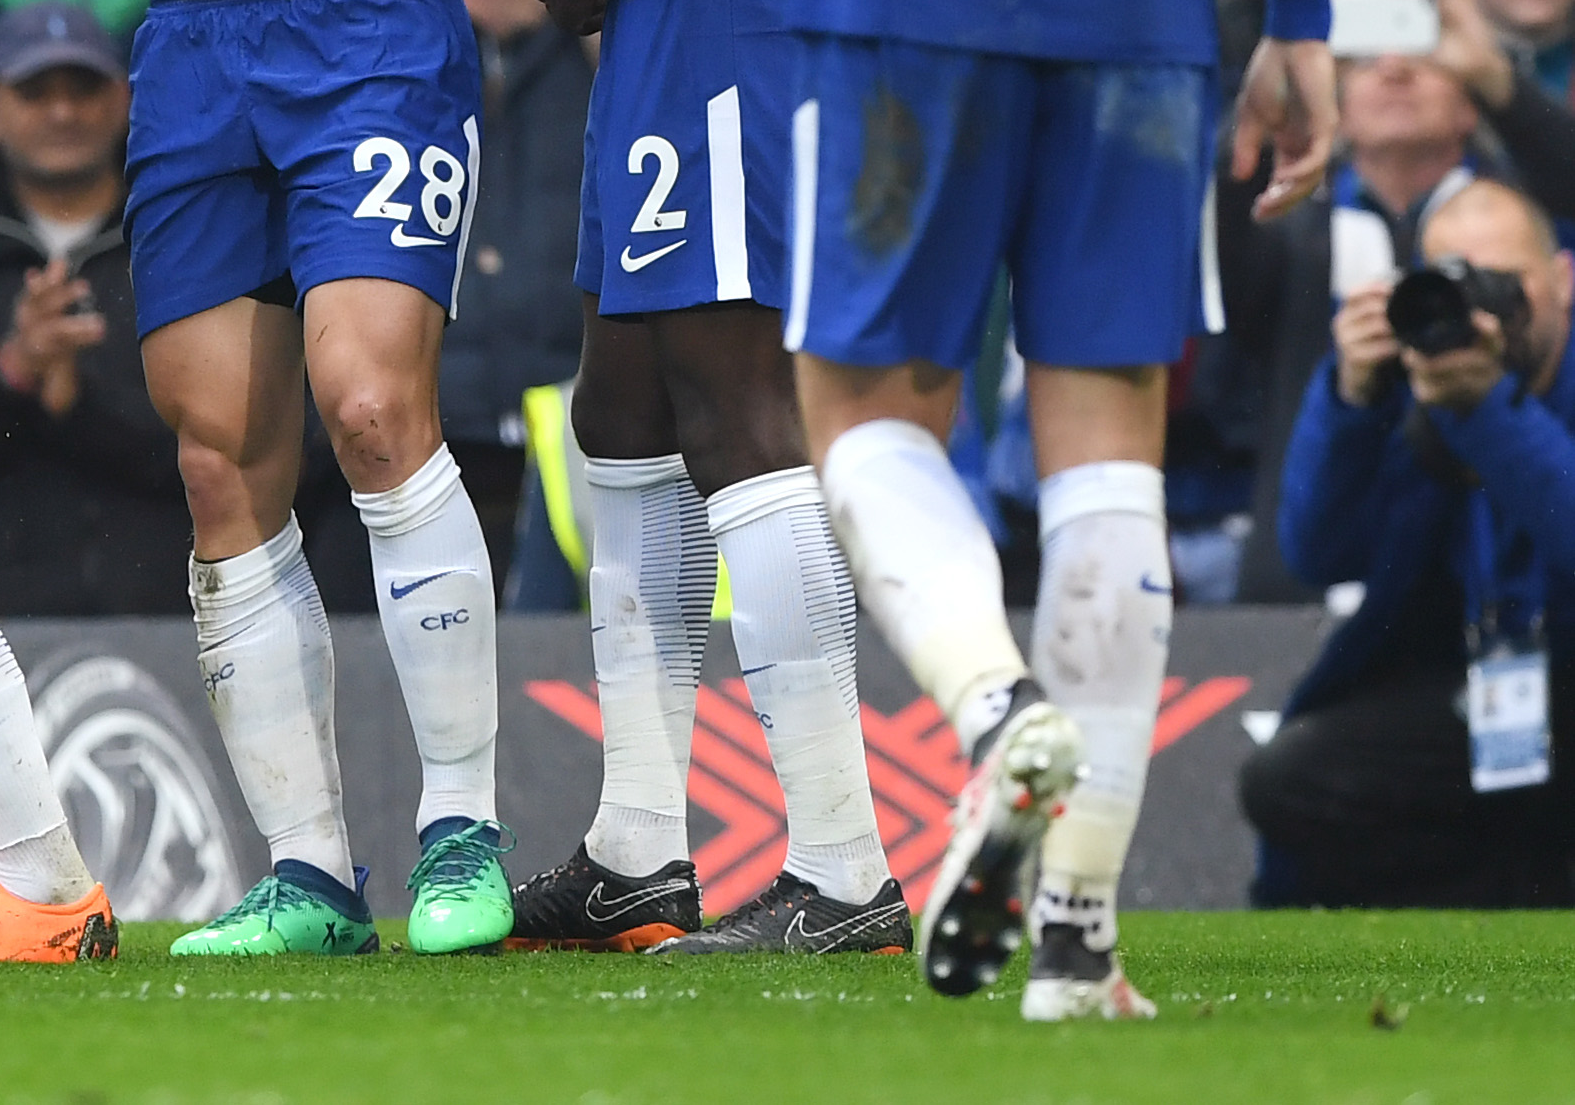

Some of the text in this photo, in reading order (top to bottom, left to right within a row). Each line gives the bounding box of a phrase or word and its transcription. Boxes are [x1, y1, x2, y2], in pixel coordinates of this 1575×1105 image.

[352, 136, 466, 237] 28
[628, 135, 687, 233] 2
[420, 609, 469, 631] CFC
[204, 663, 235, 692] CFC
